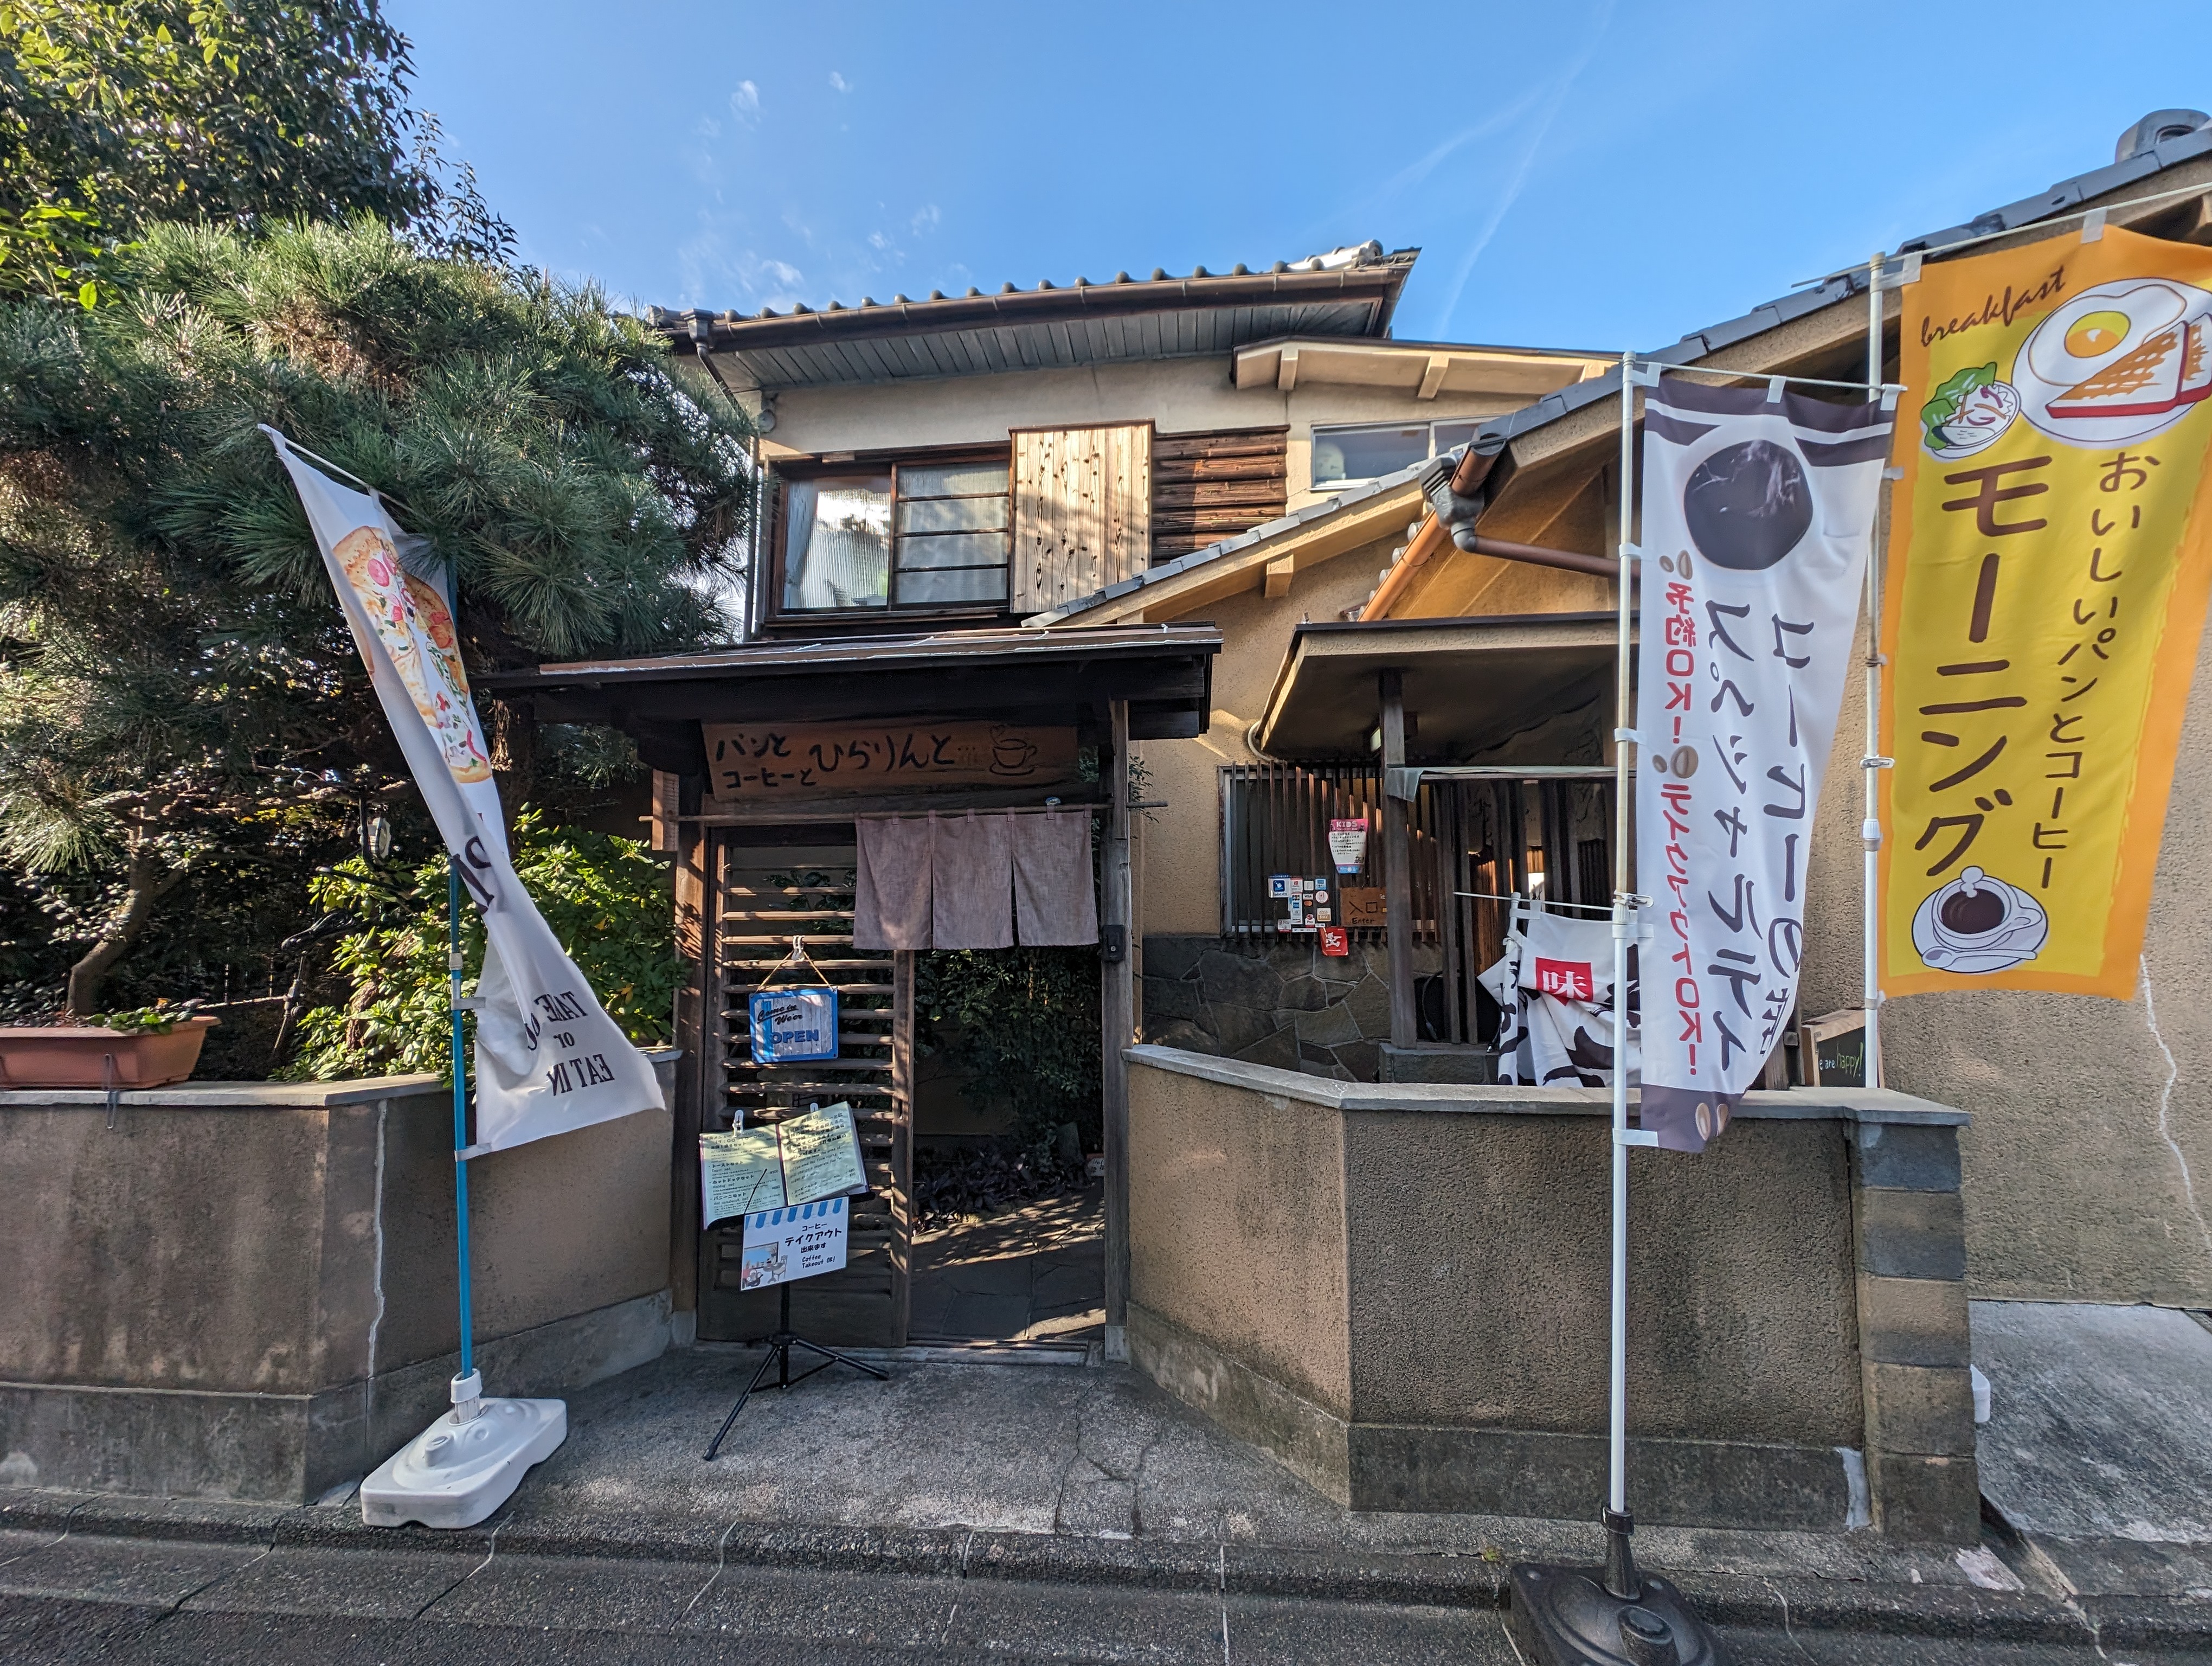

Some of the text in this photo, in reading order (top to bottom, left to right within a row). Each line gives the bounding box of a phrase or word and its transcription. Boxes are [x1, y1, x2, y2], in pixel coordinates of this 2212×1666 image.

[1921, 265, 2066, 347] breakfast
[1914, 455, 2052, 877] モーニング
[2034, 451, 2160, 889] おいしいパンとコーヒー
[716, 733, 790, 761] パンと
[723, 767, 816, 789] コーヒーと
[1542, 970, 1589, 1000] 味
[771, 1029, 819, 1044] OPEN
[1825, 1059, 1835, 1069] are
[1837, 1042, 1863, 1078] happy!
[785, 1228, 841, 1247] テイクアウト
[802, 1223, 827, 1232] コーヒー
[801, 1242, 826, 1253] 出来ます
[802, 1254, 821, 1263] Coffee
[802, 1260, 824, 1268] Takeout
